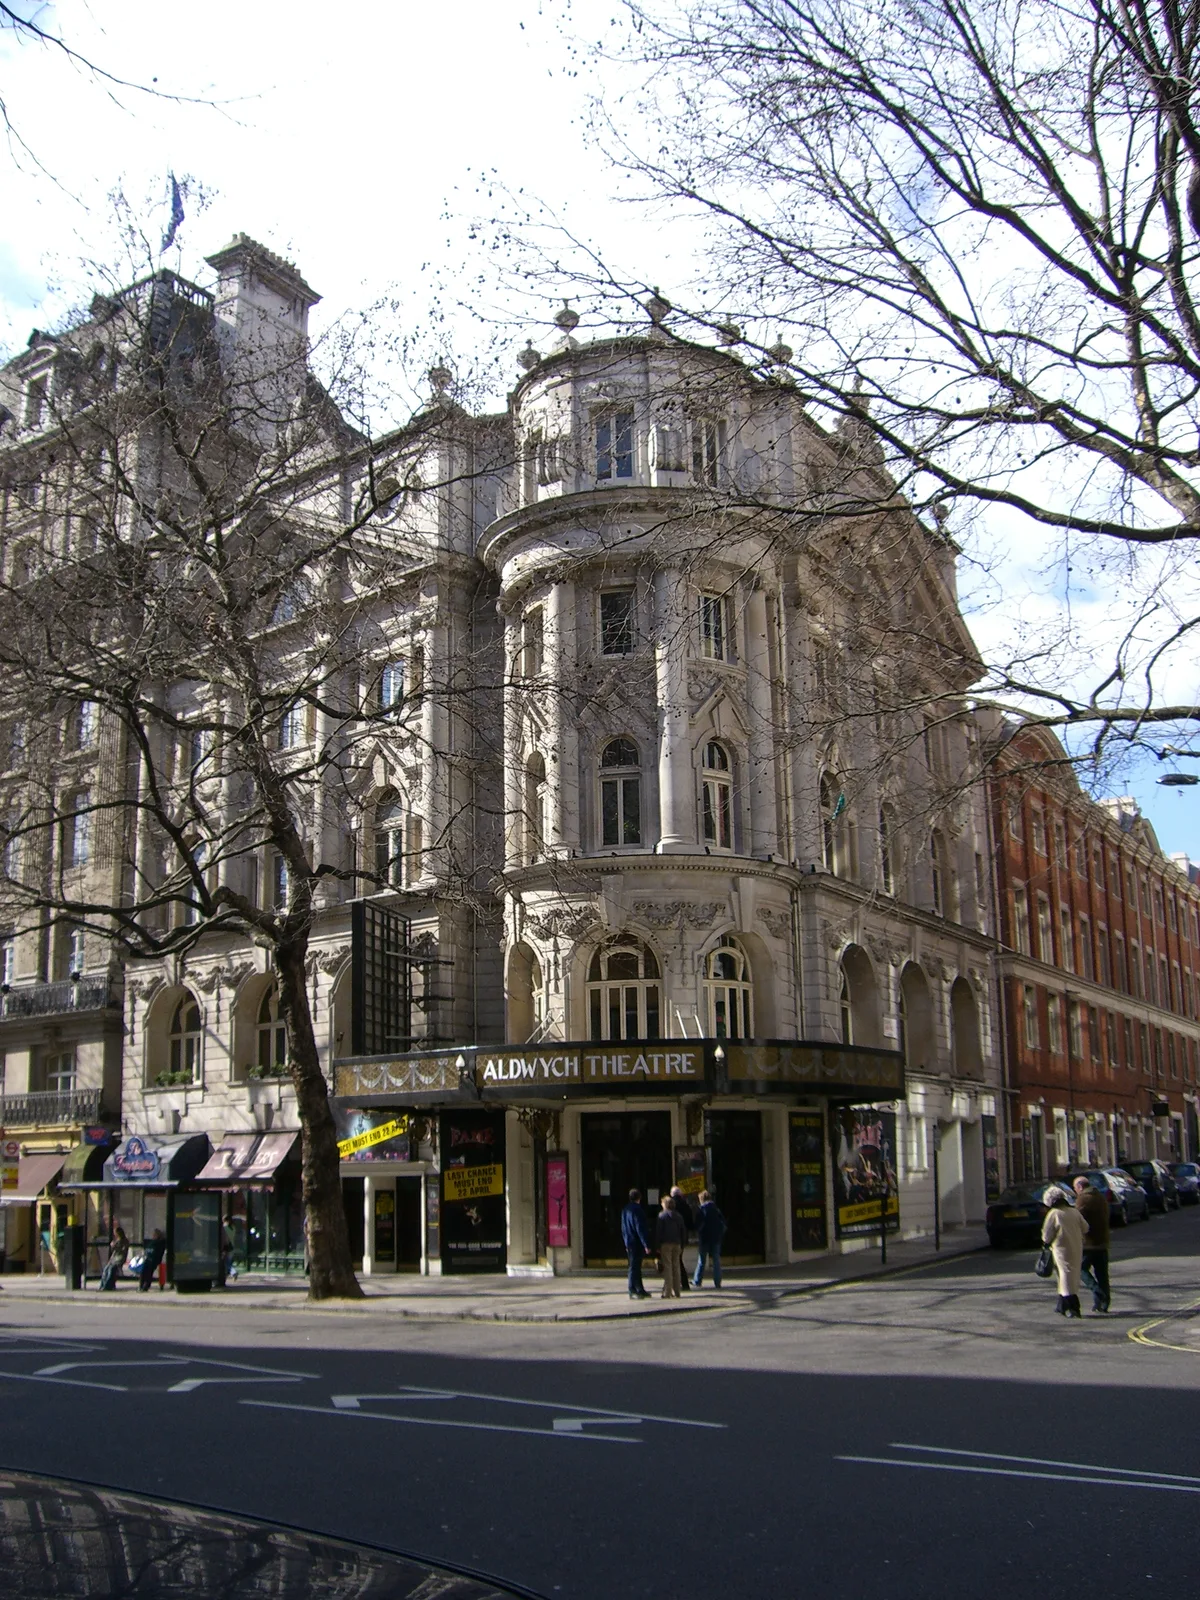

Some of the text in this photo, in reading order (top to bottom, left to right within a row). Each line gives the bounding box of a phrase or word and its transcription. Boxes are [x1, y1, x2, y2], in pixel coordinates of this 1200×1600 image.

[483, 1053, 696, 1081] ALDWYCH THEATRE
[369, 1130, 381, 1142] END
[382, 1127, 391, 1137] 22
[447, 1167, 497, 1181] LAST CHANCE
[454, 1176, 493, 1189] MUST END
[457, 1185, 491, 1198] 22 APRIL
